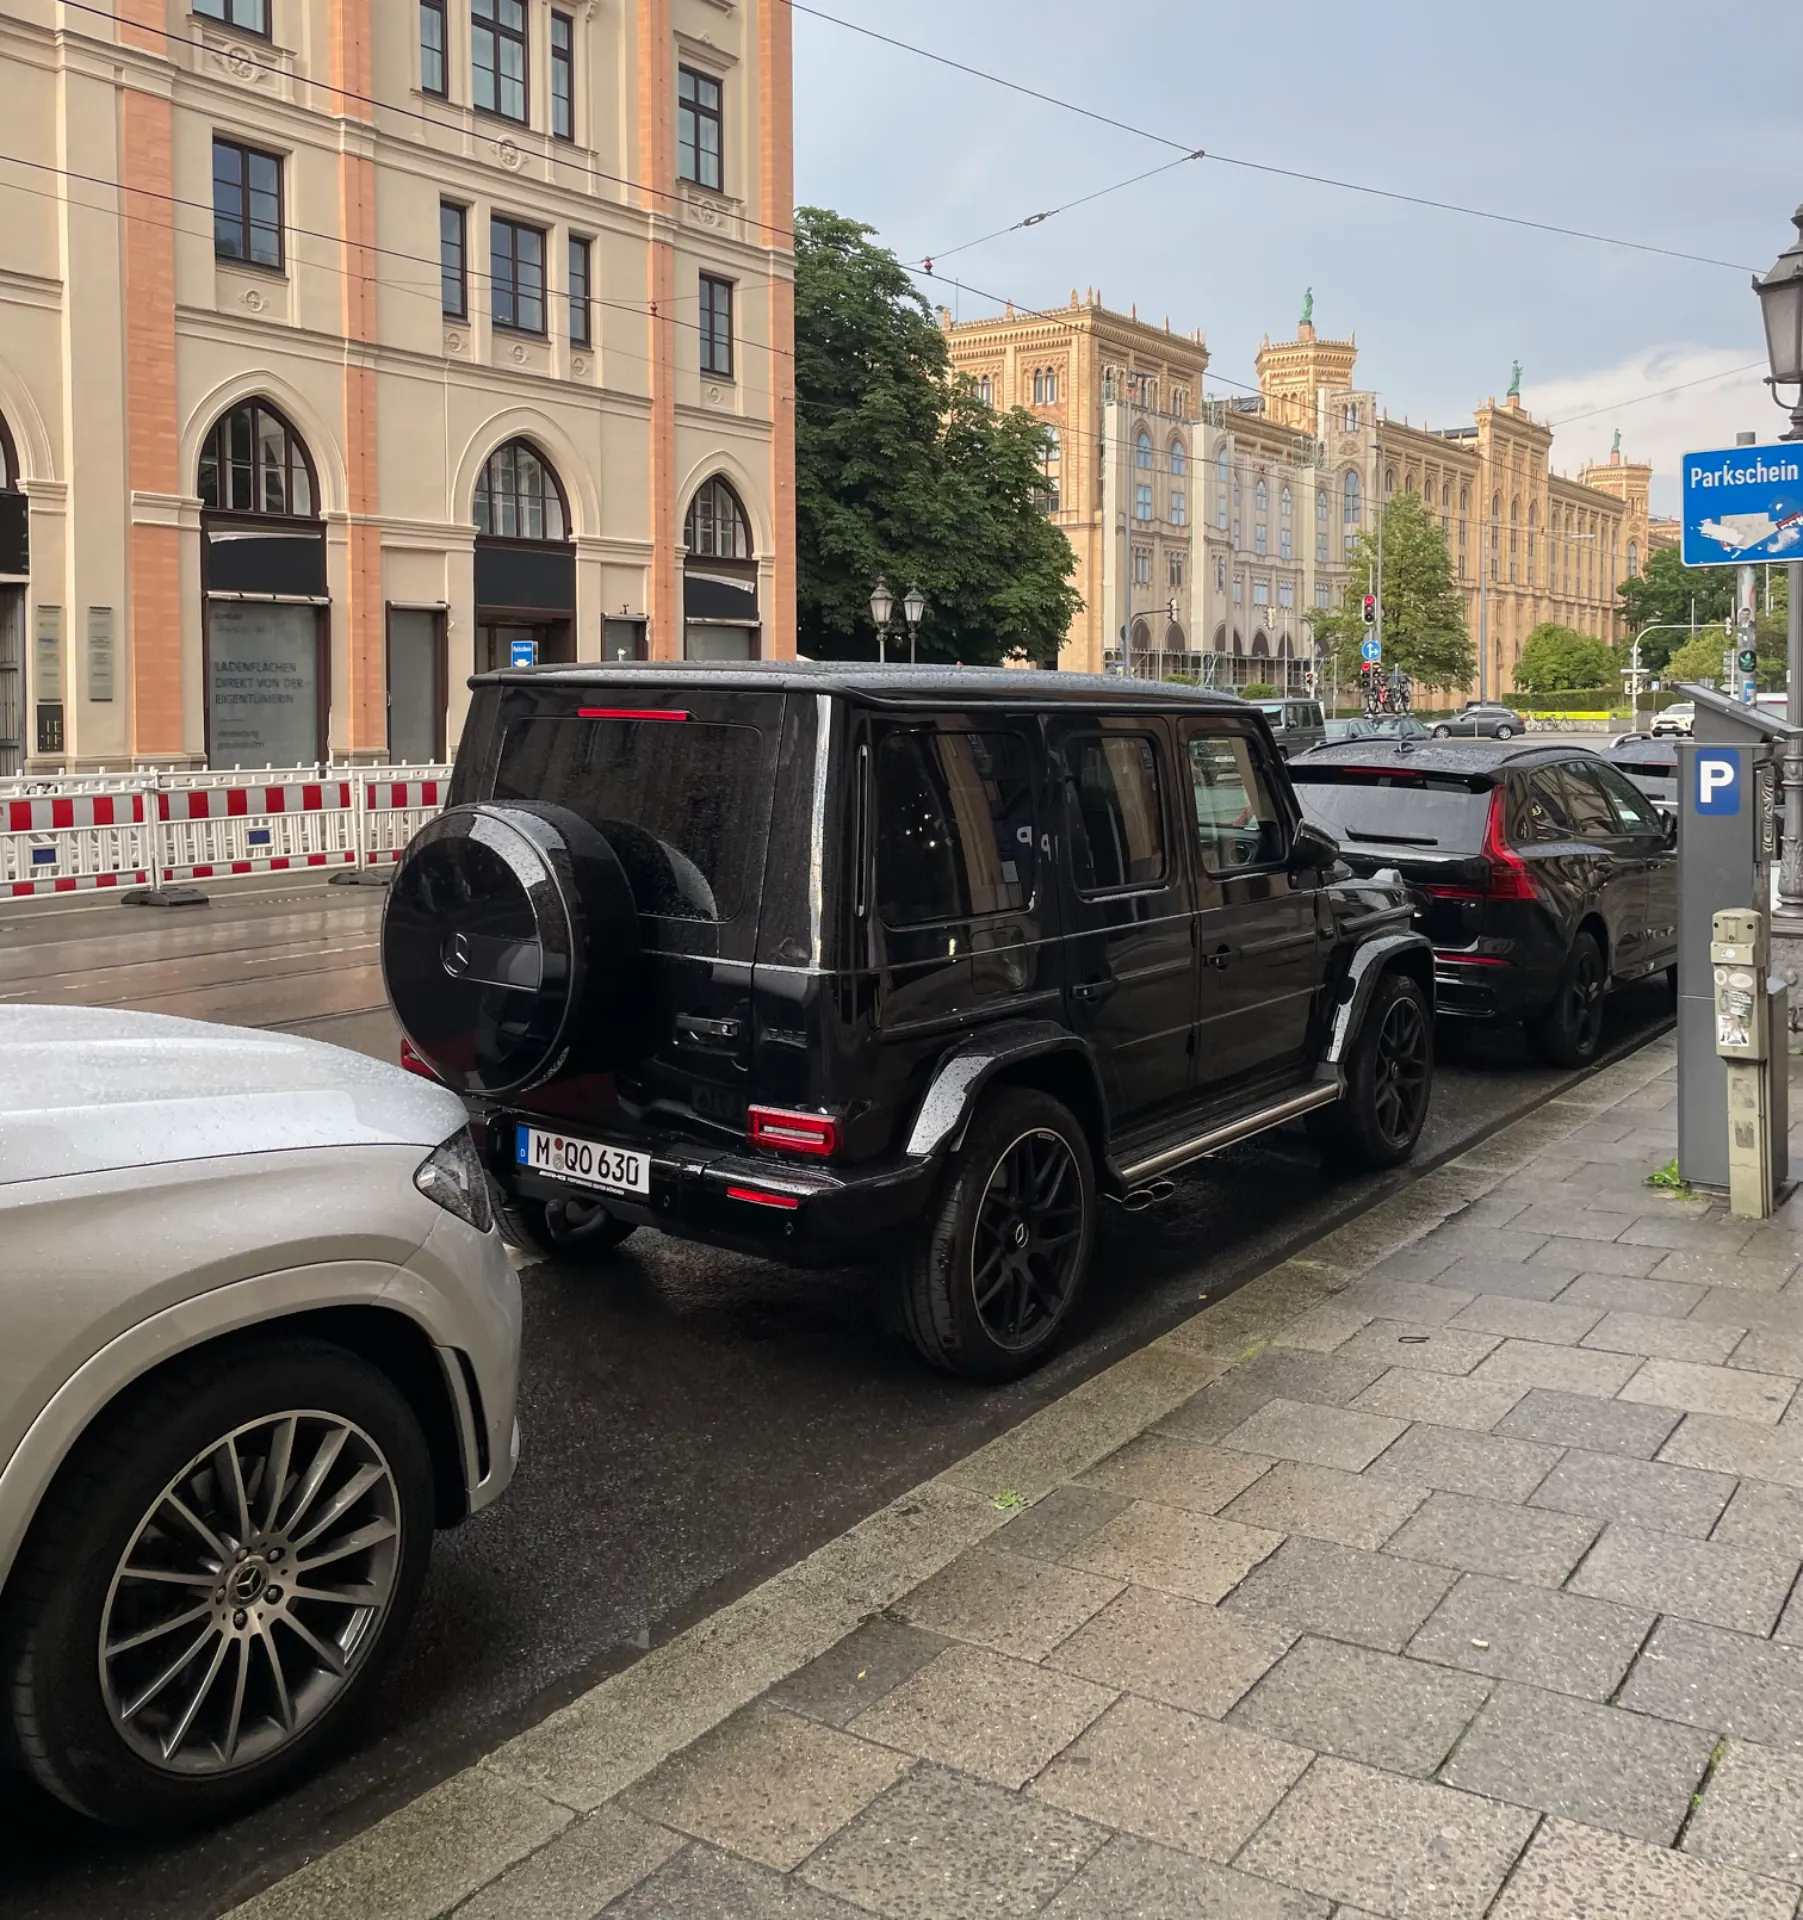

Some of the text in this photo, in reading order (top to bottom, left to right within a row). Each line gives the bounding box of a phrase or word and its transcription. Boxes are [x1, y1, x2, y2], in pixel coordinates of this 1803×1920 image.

[1690, 460, 1799, 489] Parkschein
[257, 677, 279, 688] VON
[1700, 761, 1734, 803] P
[520, 1150, 526, 1158] D
[536, 1134, 640, 1186] M QO 630
